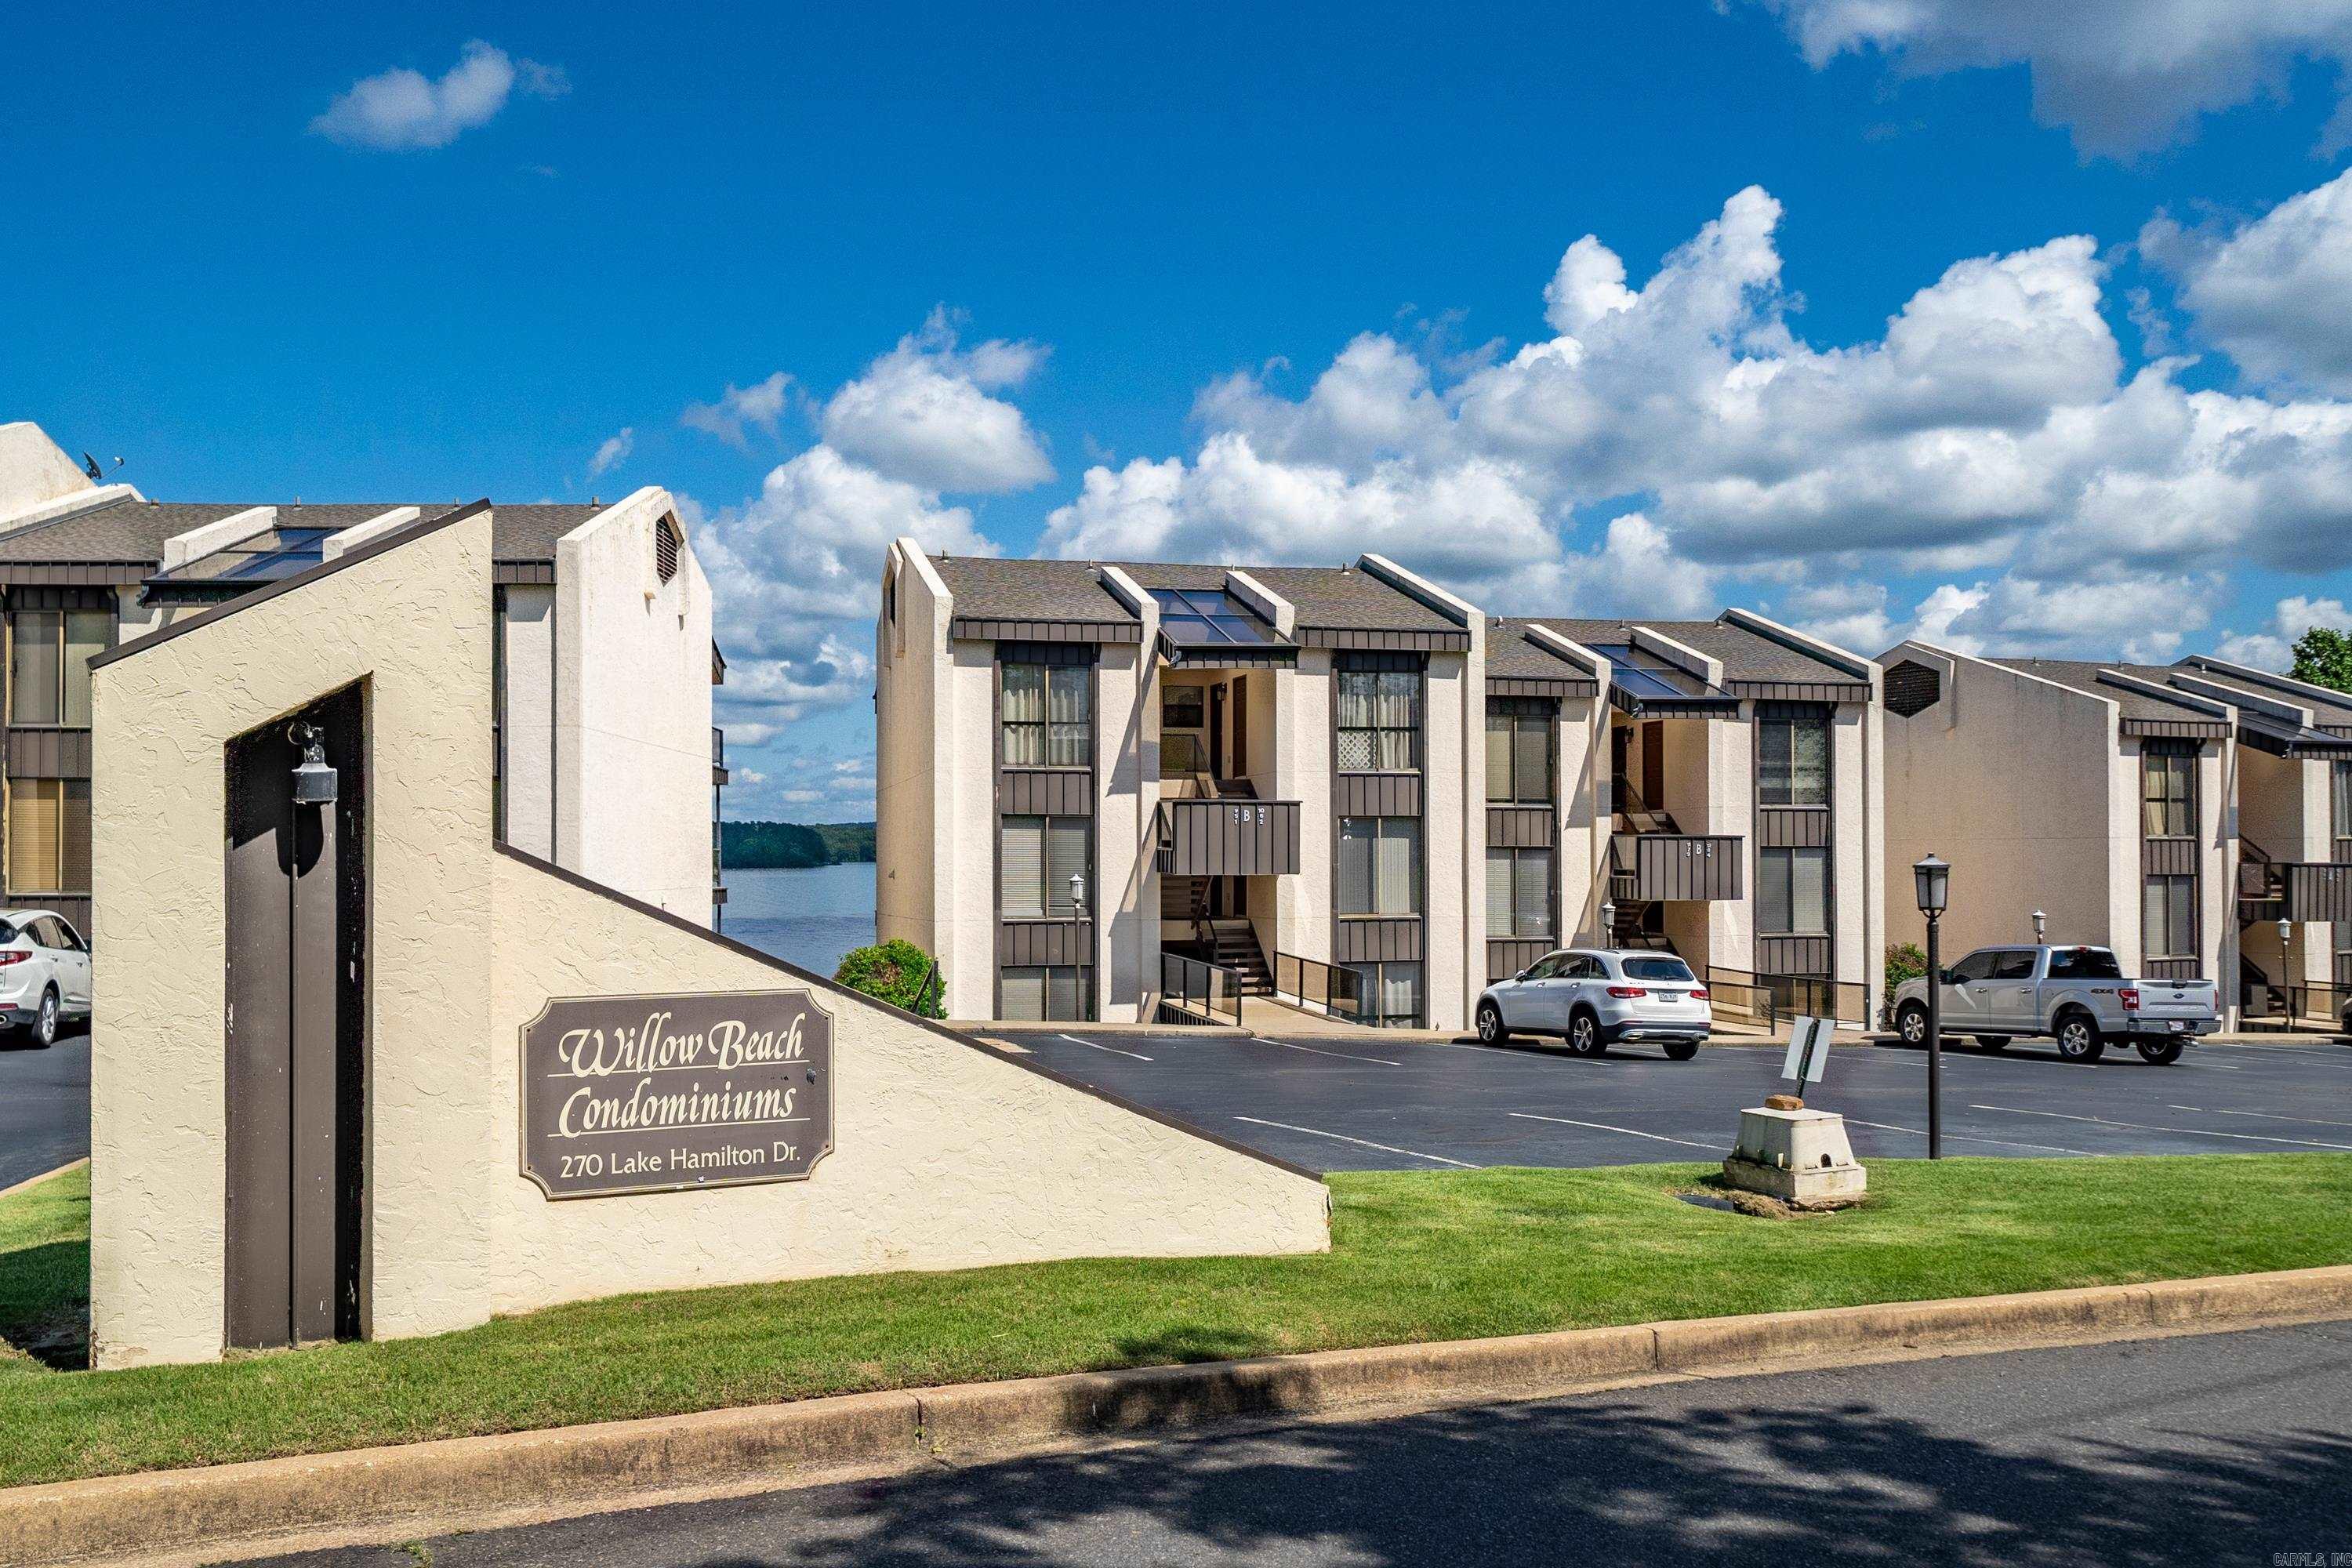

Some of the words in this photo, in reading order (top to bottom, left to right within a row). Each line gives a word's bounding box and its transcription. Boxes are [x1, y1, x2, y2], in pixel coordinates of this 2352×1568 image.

[1243, 809, 1250, 822] B
[1696, 844, 1702, 855] B
[558, 1011, 704, 1078] Willow
[708, 1012, 806, 1069] Beach
[558, 1077, 797, 1138] Condominiums
[560, 1153, 603, 1178] 270
[611, 1152, 662, 1175] Lake
[670, 1145, 765, 1171] Hamilton
[773, 1141, 800, 1163] Dr.
